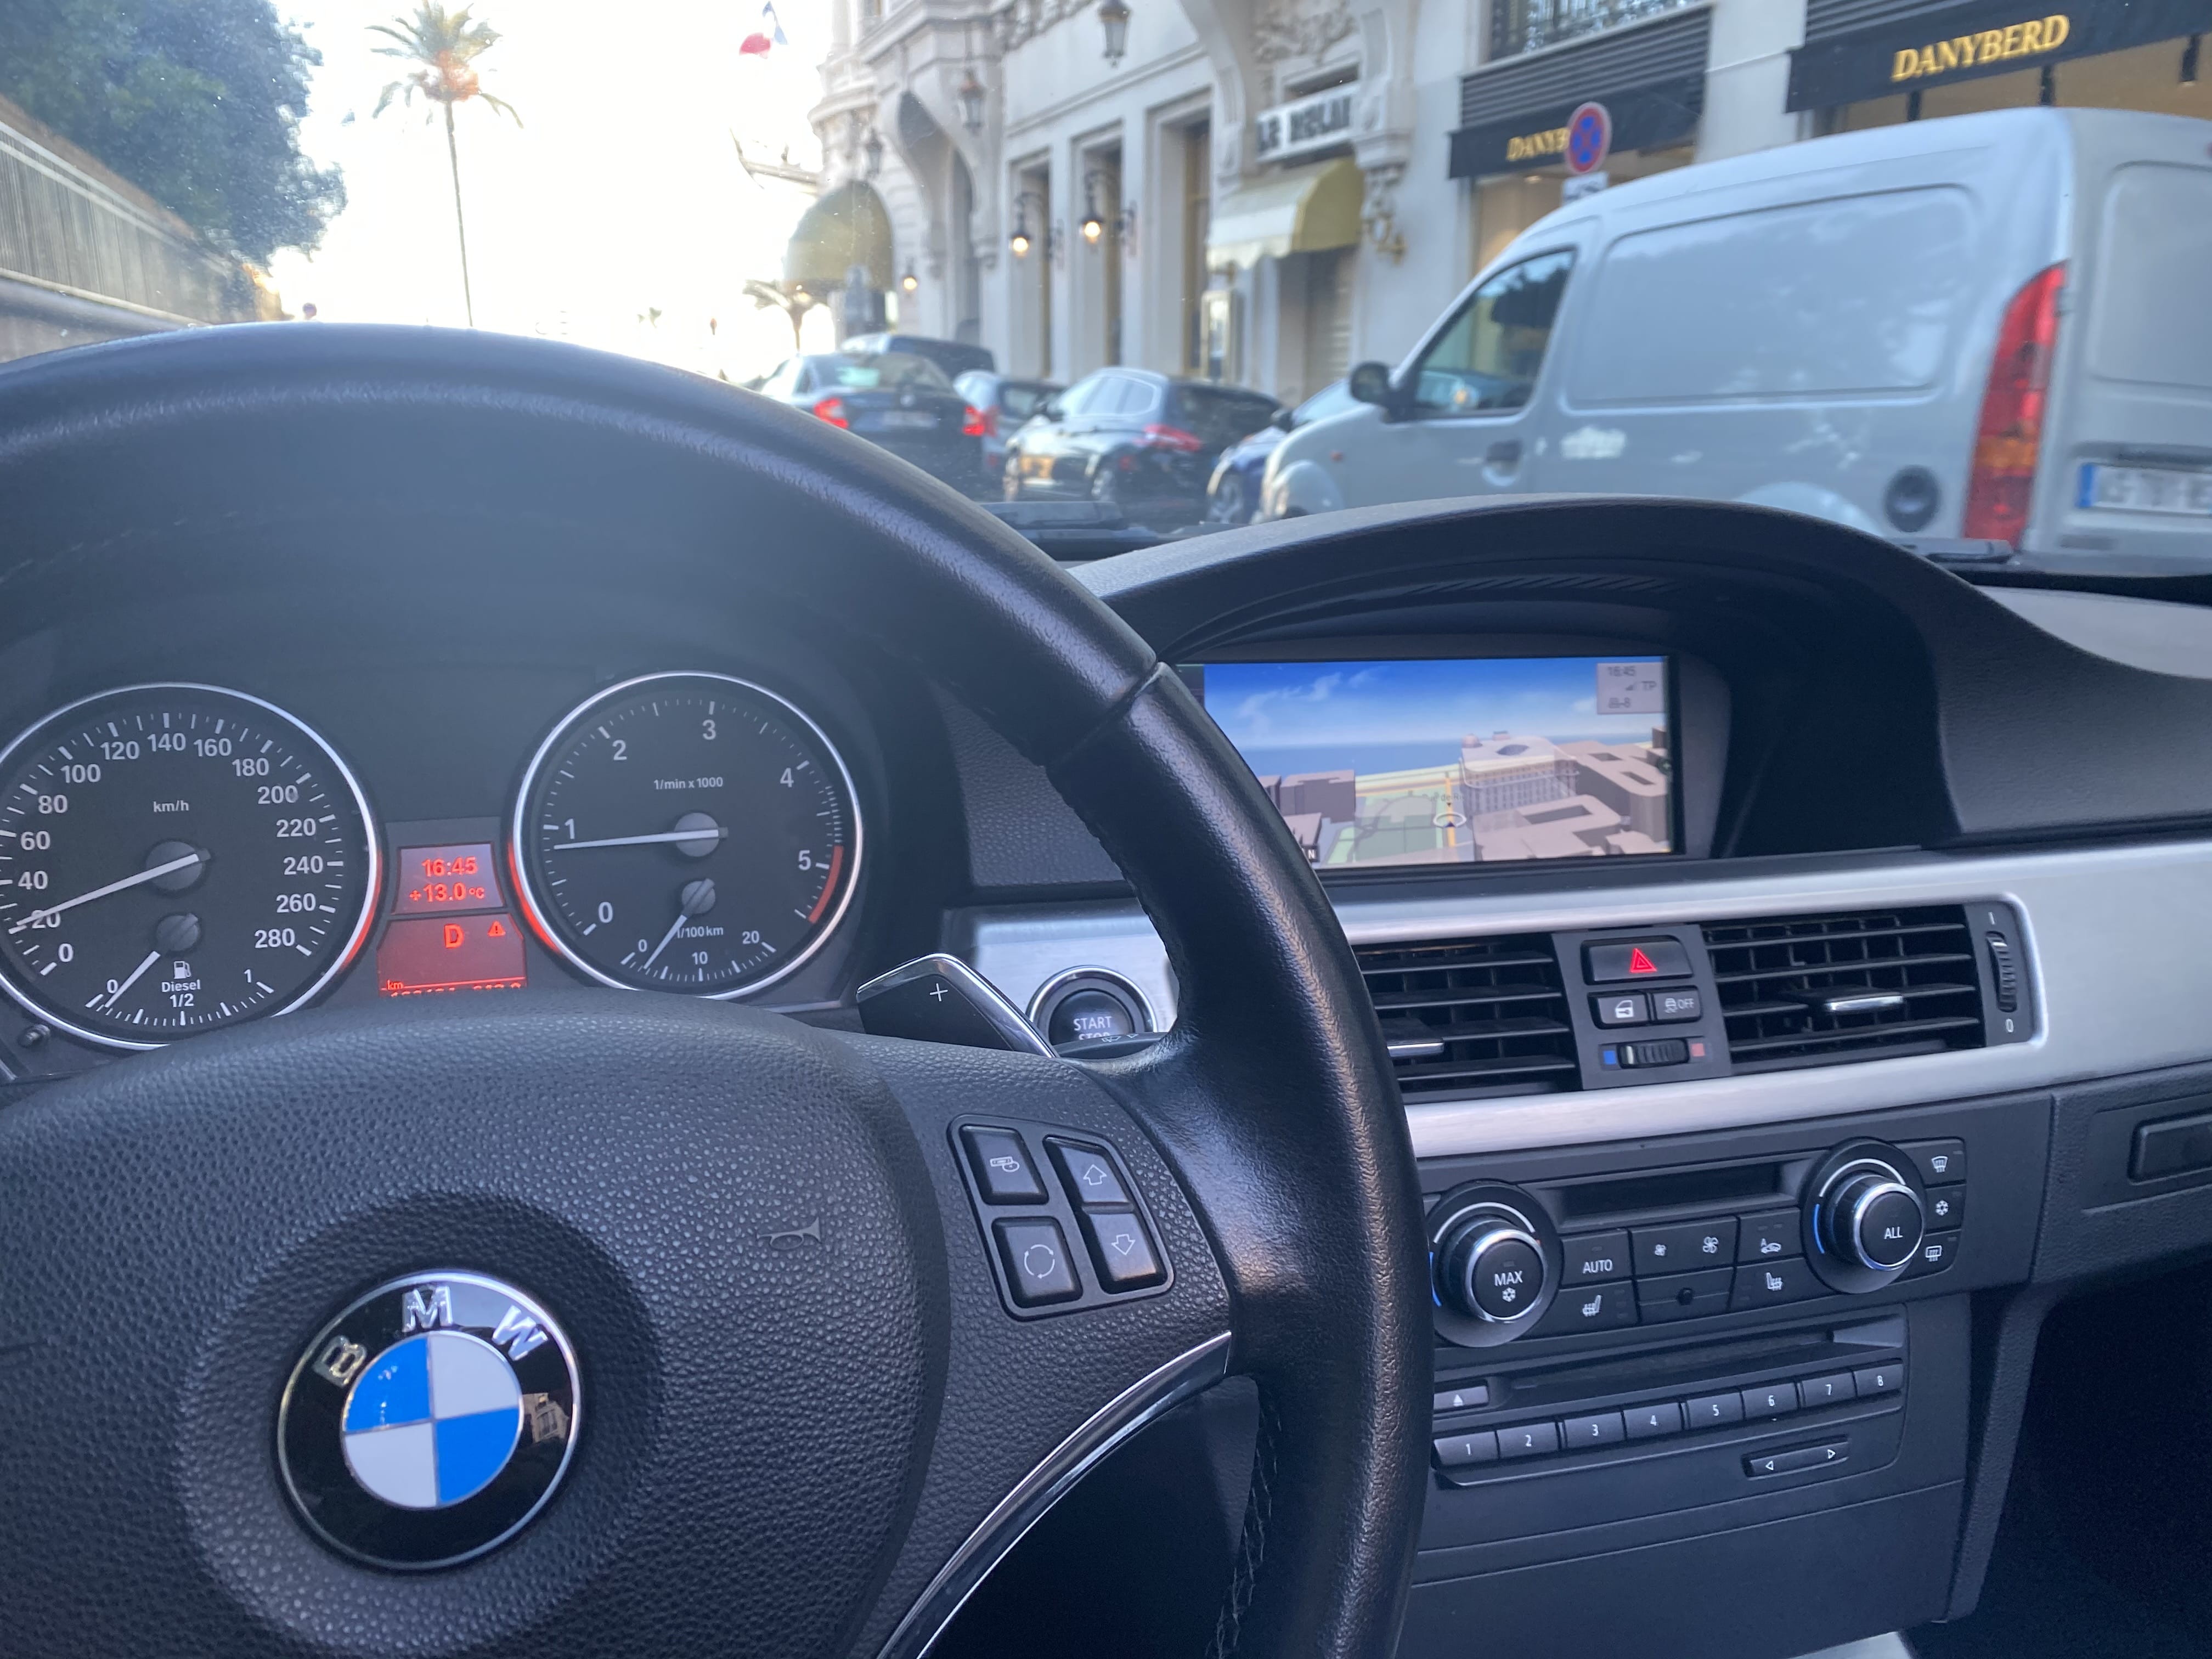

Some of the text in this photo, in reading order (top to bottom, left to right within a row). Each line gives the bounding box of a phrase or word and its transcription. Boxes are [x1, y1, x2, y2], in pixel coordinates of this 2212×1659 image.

[1891, 14, 2070, 81] DANYBERD
[702, 720, 716, 740] 3
[101, 741, 140, 760] 120
[148, 732, 186, 752] 140
[194, 738, 232, 757] 160
[612, 740, 627, 760] 2
[61, 764, 101, 783] 100
[232, 758, 269, 776] 180
[654, 777, 723, 789] 1/min x 1000
[780, 768, 794, 787] 4
[257, 785, 299, 804] 200
[38, 794, 67, 814] 80
[153, 800, 189, 812] km/h
[276, 818, 316, 837] 220
[565, 819, 575, 839] 1
[21, 831, 50, 850] 60
[283, 855, 323, 875] 240
[421, 856, 478, 877] 16:45
[798, 850, 811, 870] 5
[18, 870, 48, 889] 40
[276, 893, 316, 912] 260
[31, 910, 60, 928] 20
[599, 901, 613, 923] 0
[255, 928, 295, 948] 280
[444, 923, 464, 949] D
[706, 926, 724, 936] km
[742, 930, 760, 944] 20
[59, 943, 73, 962] 0
[638, 939, 647, 952] 0
[692, 951, 708, 964] 10
[244, 969, 252, 983] 1
[106, 979, 119, 994] 0
[161, 979, 201, 992] Diesel
[170, 993, 194, 1007] 1/2
[1678, 998, 1695, 1009] OFF
[1073, 1016, 1113, 1031] START
[1884, 1227, 1903, 1239] ALL
[1582, 1259, 1613, 1274] AUTO
[1494, 1271, 1523, 1286] MAX
[312, 1286, 548, 1387] BMW
[1825, 1384, 1832, 1396] 7
[1877, 1375, 1884, 1387] 8
[1768, 1395, 1775, 1407] 6
[1713, 1404, 1720, 1417] 5
[1650, 1415, 1658, 1426] 4
[1592, 1424, 1599, 1436] 3
[1465, 1443, 1472, 1456] 1
[1525, 1435, 1532, 1447] 2
